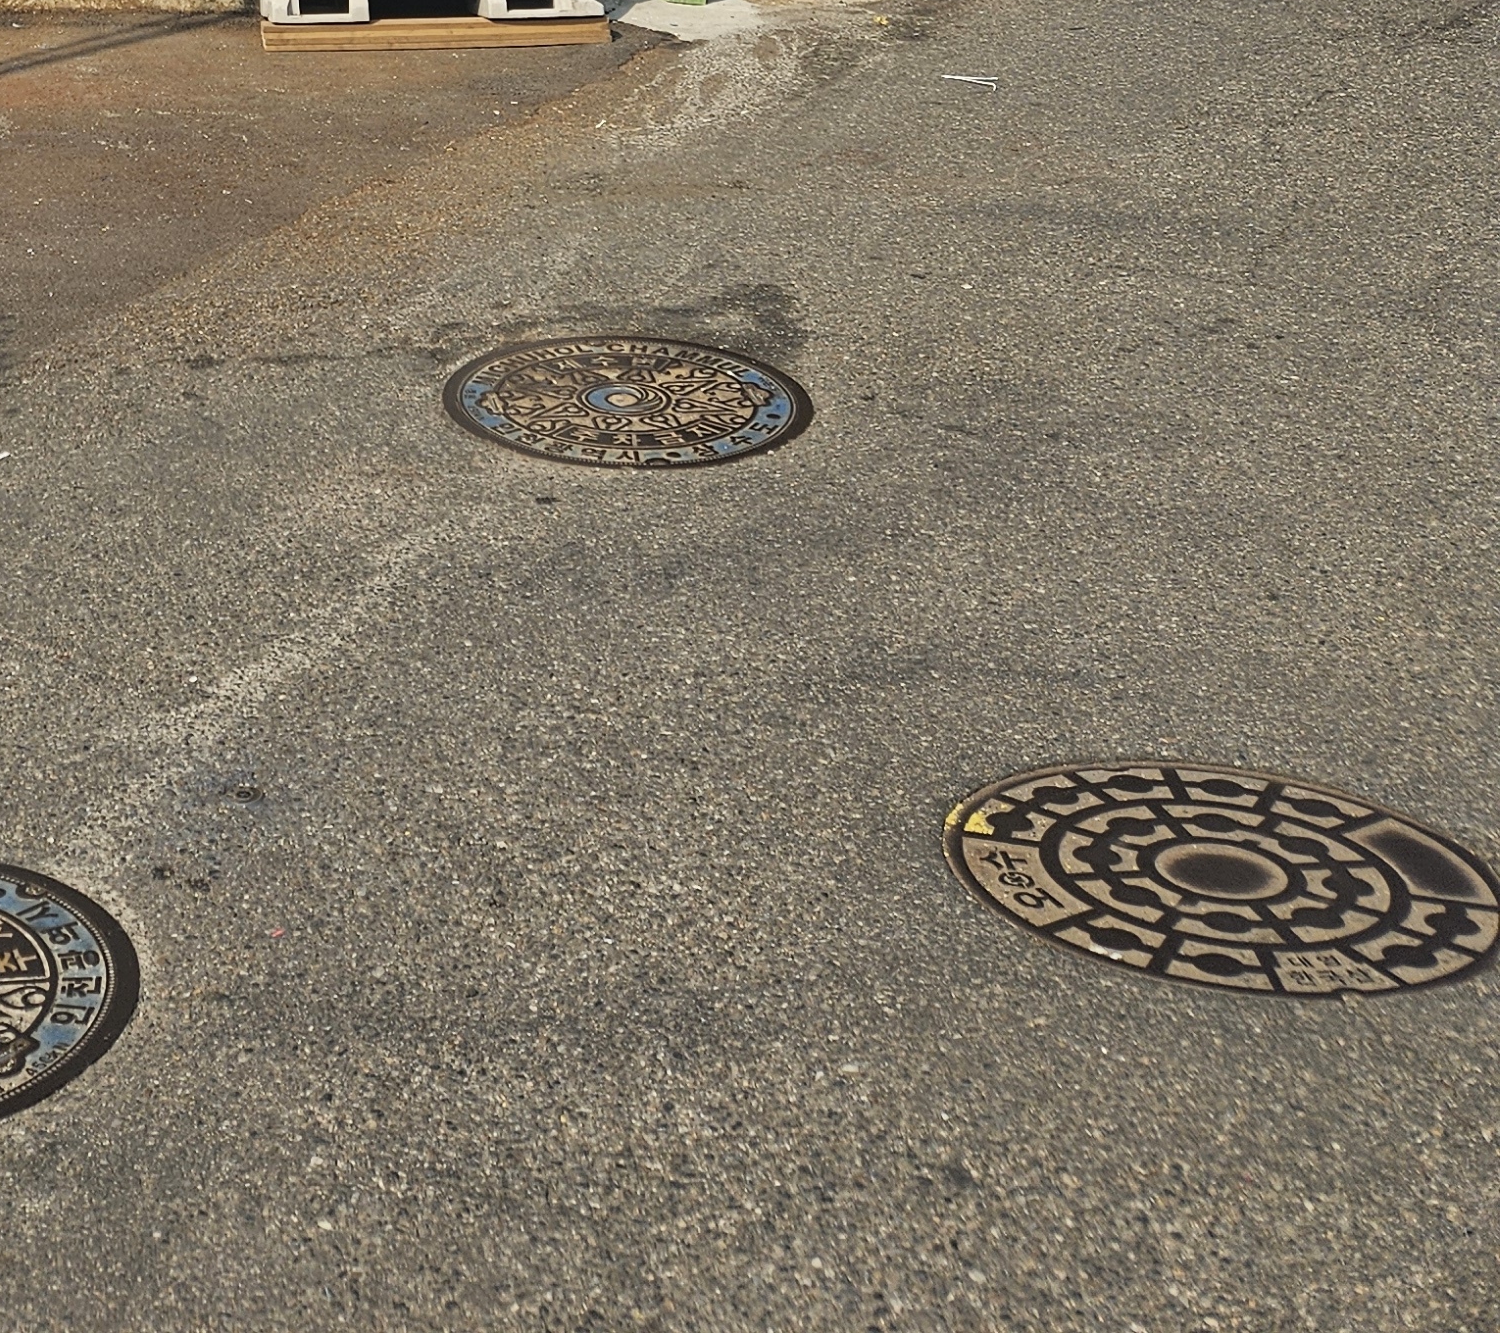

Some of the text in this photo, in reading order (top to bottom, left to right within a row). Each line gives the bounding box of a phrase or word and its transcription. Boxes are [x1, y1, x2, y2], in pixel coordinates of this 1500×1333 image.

[471, 343, 751, 387] MICHUHOL CHAMMUL
[489, 421, 780, 464] 인천광역시 상수도
[15, 899, 104, 1027] 인천광역시
